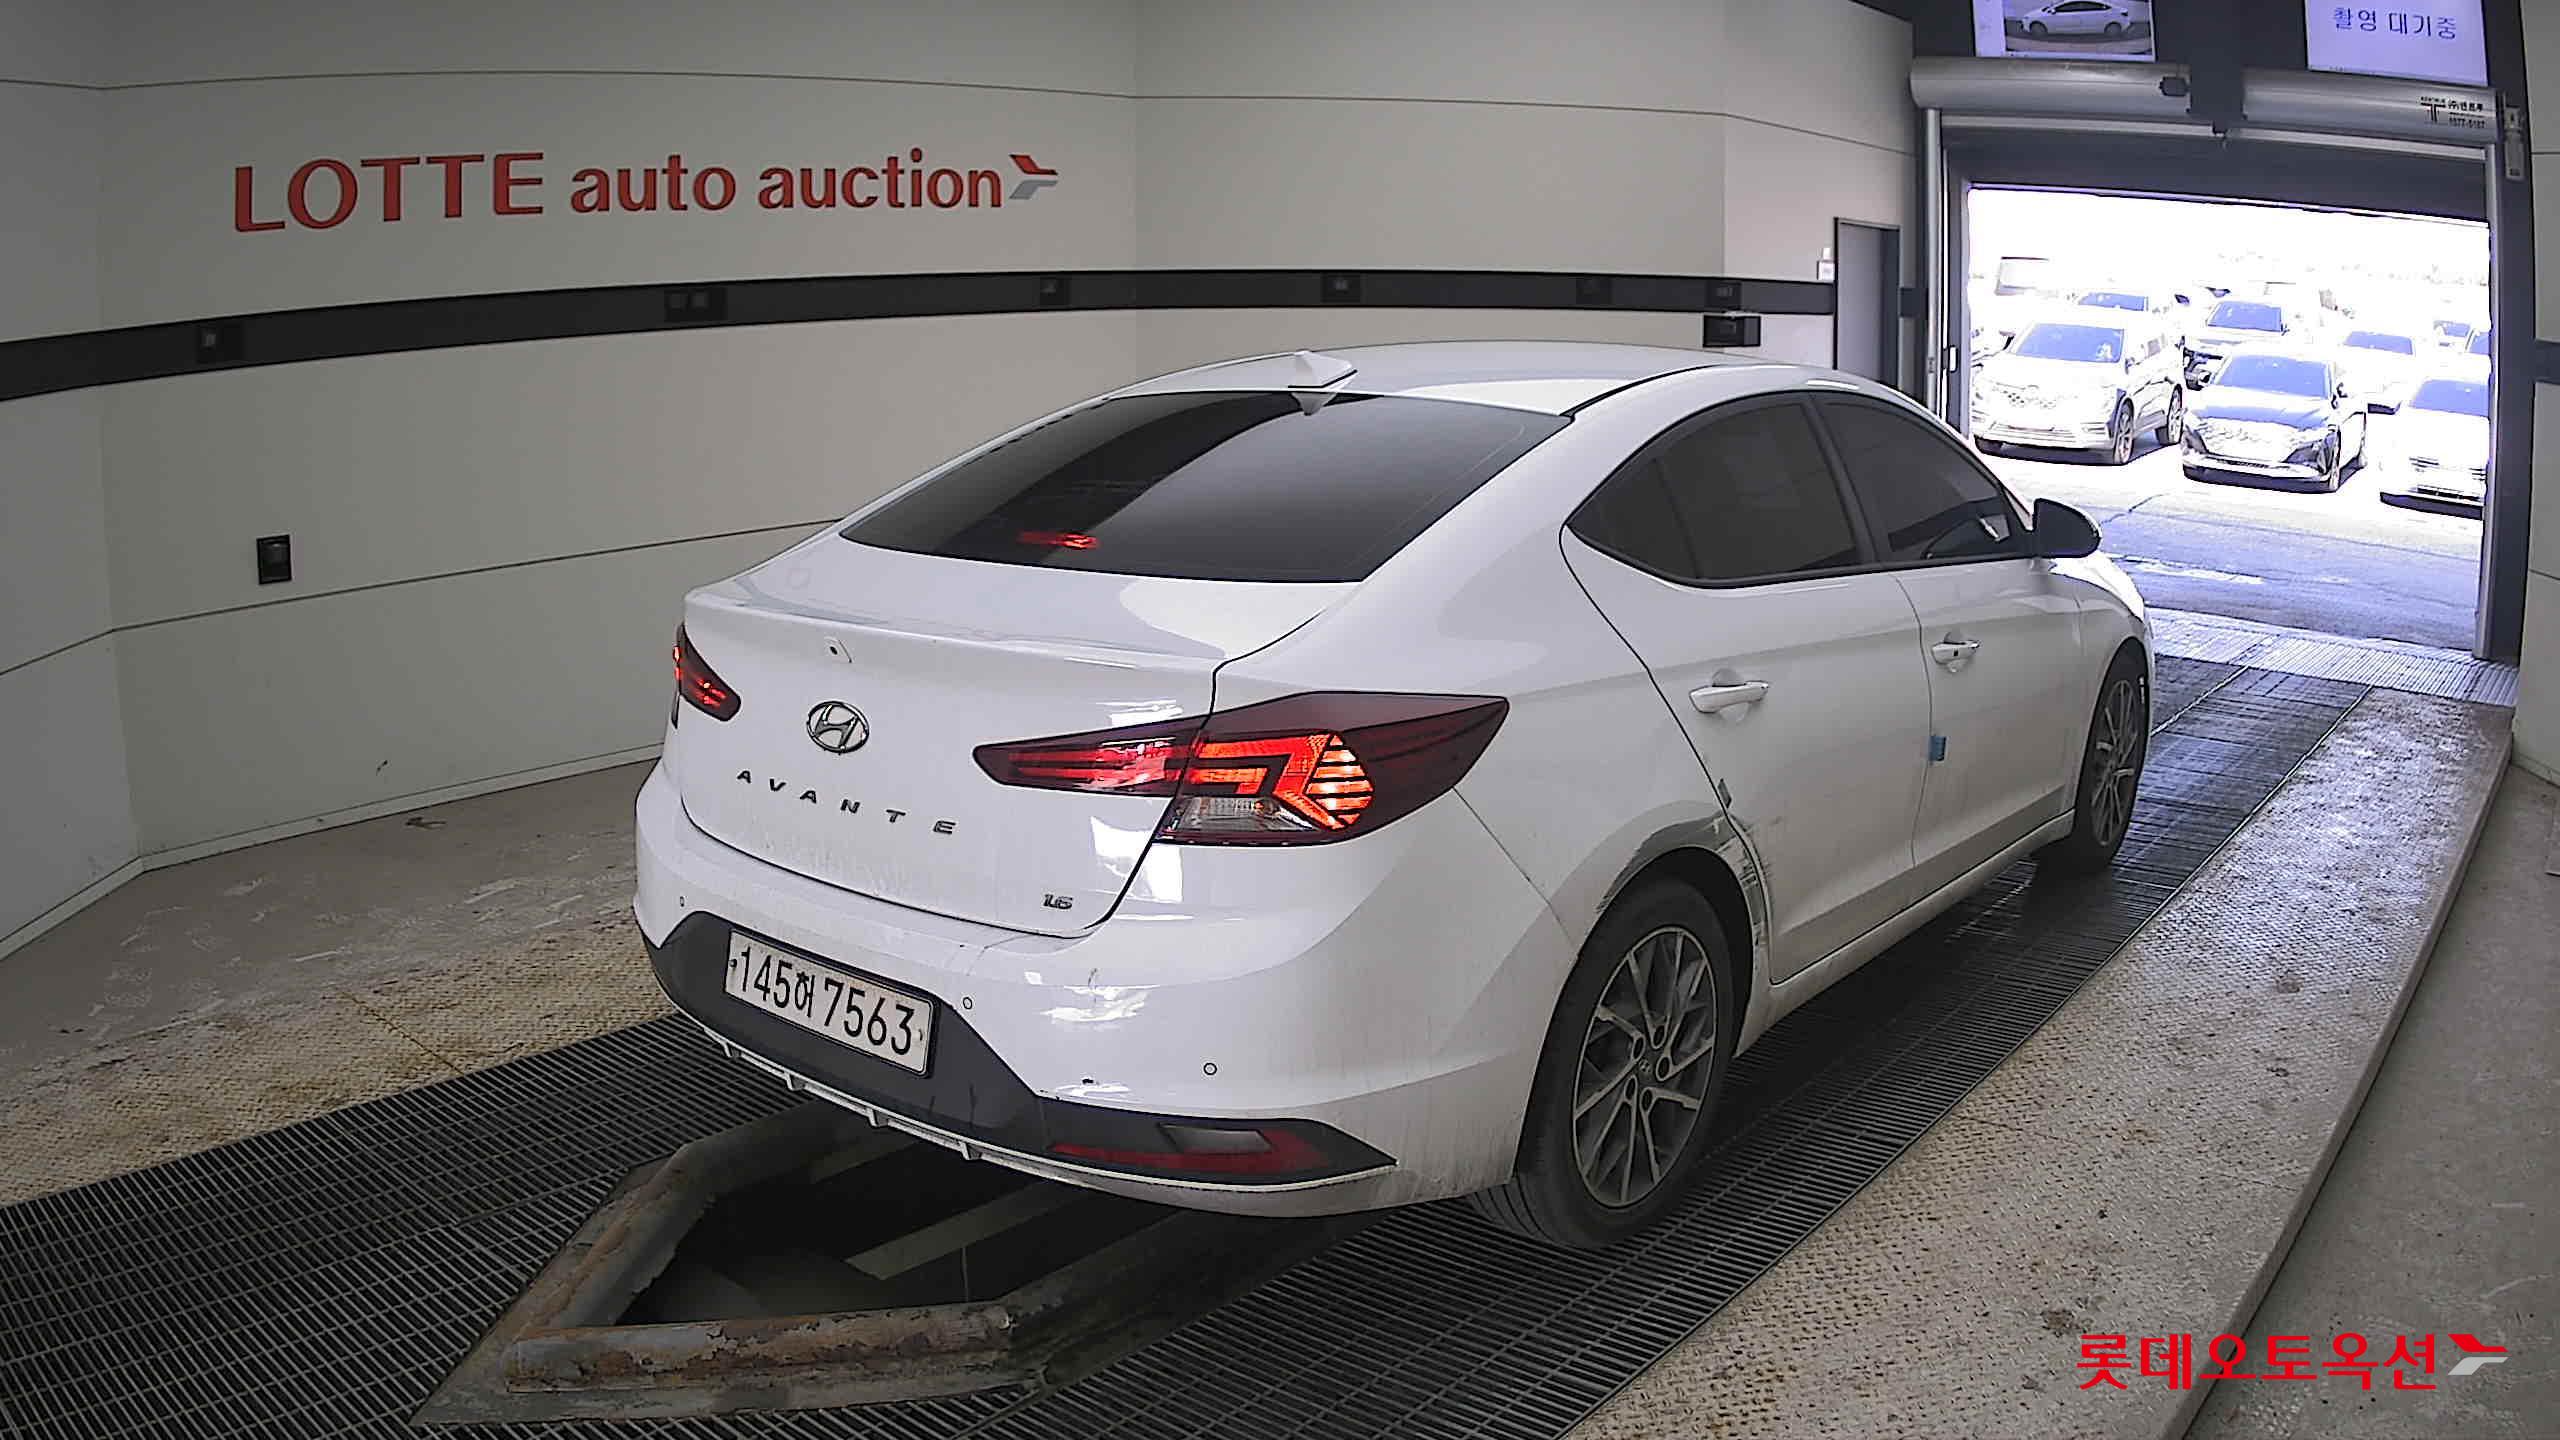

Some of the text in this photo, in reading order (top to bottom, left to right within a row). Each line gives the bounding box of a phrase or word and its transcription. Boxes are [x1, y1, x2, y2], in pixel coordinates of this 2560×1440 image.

[2334, 7, 2457, 40] 촬영 대기중
[234, 147, 1003, 233] LOTTE auto auction
[736, 770, 956, 835] AVANTE
